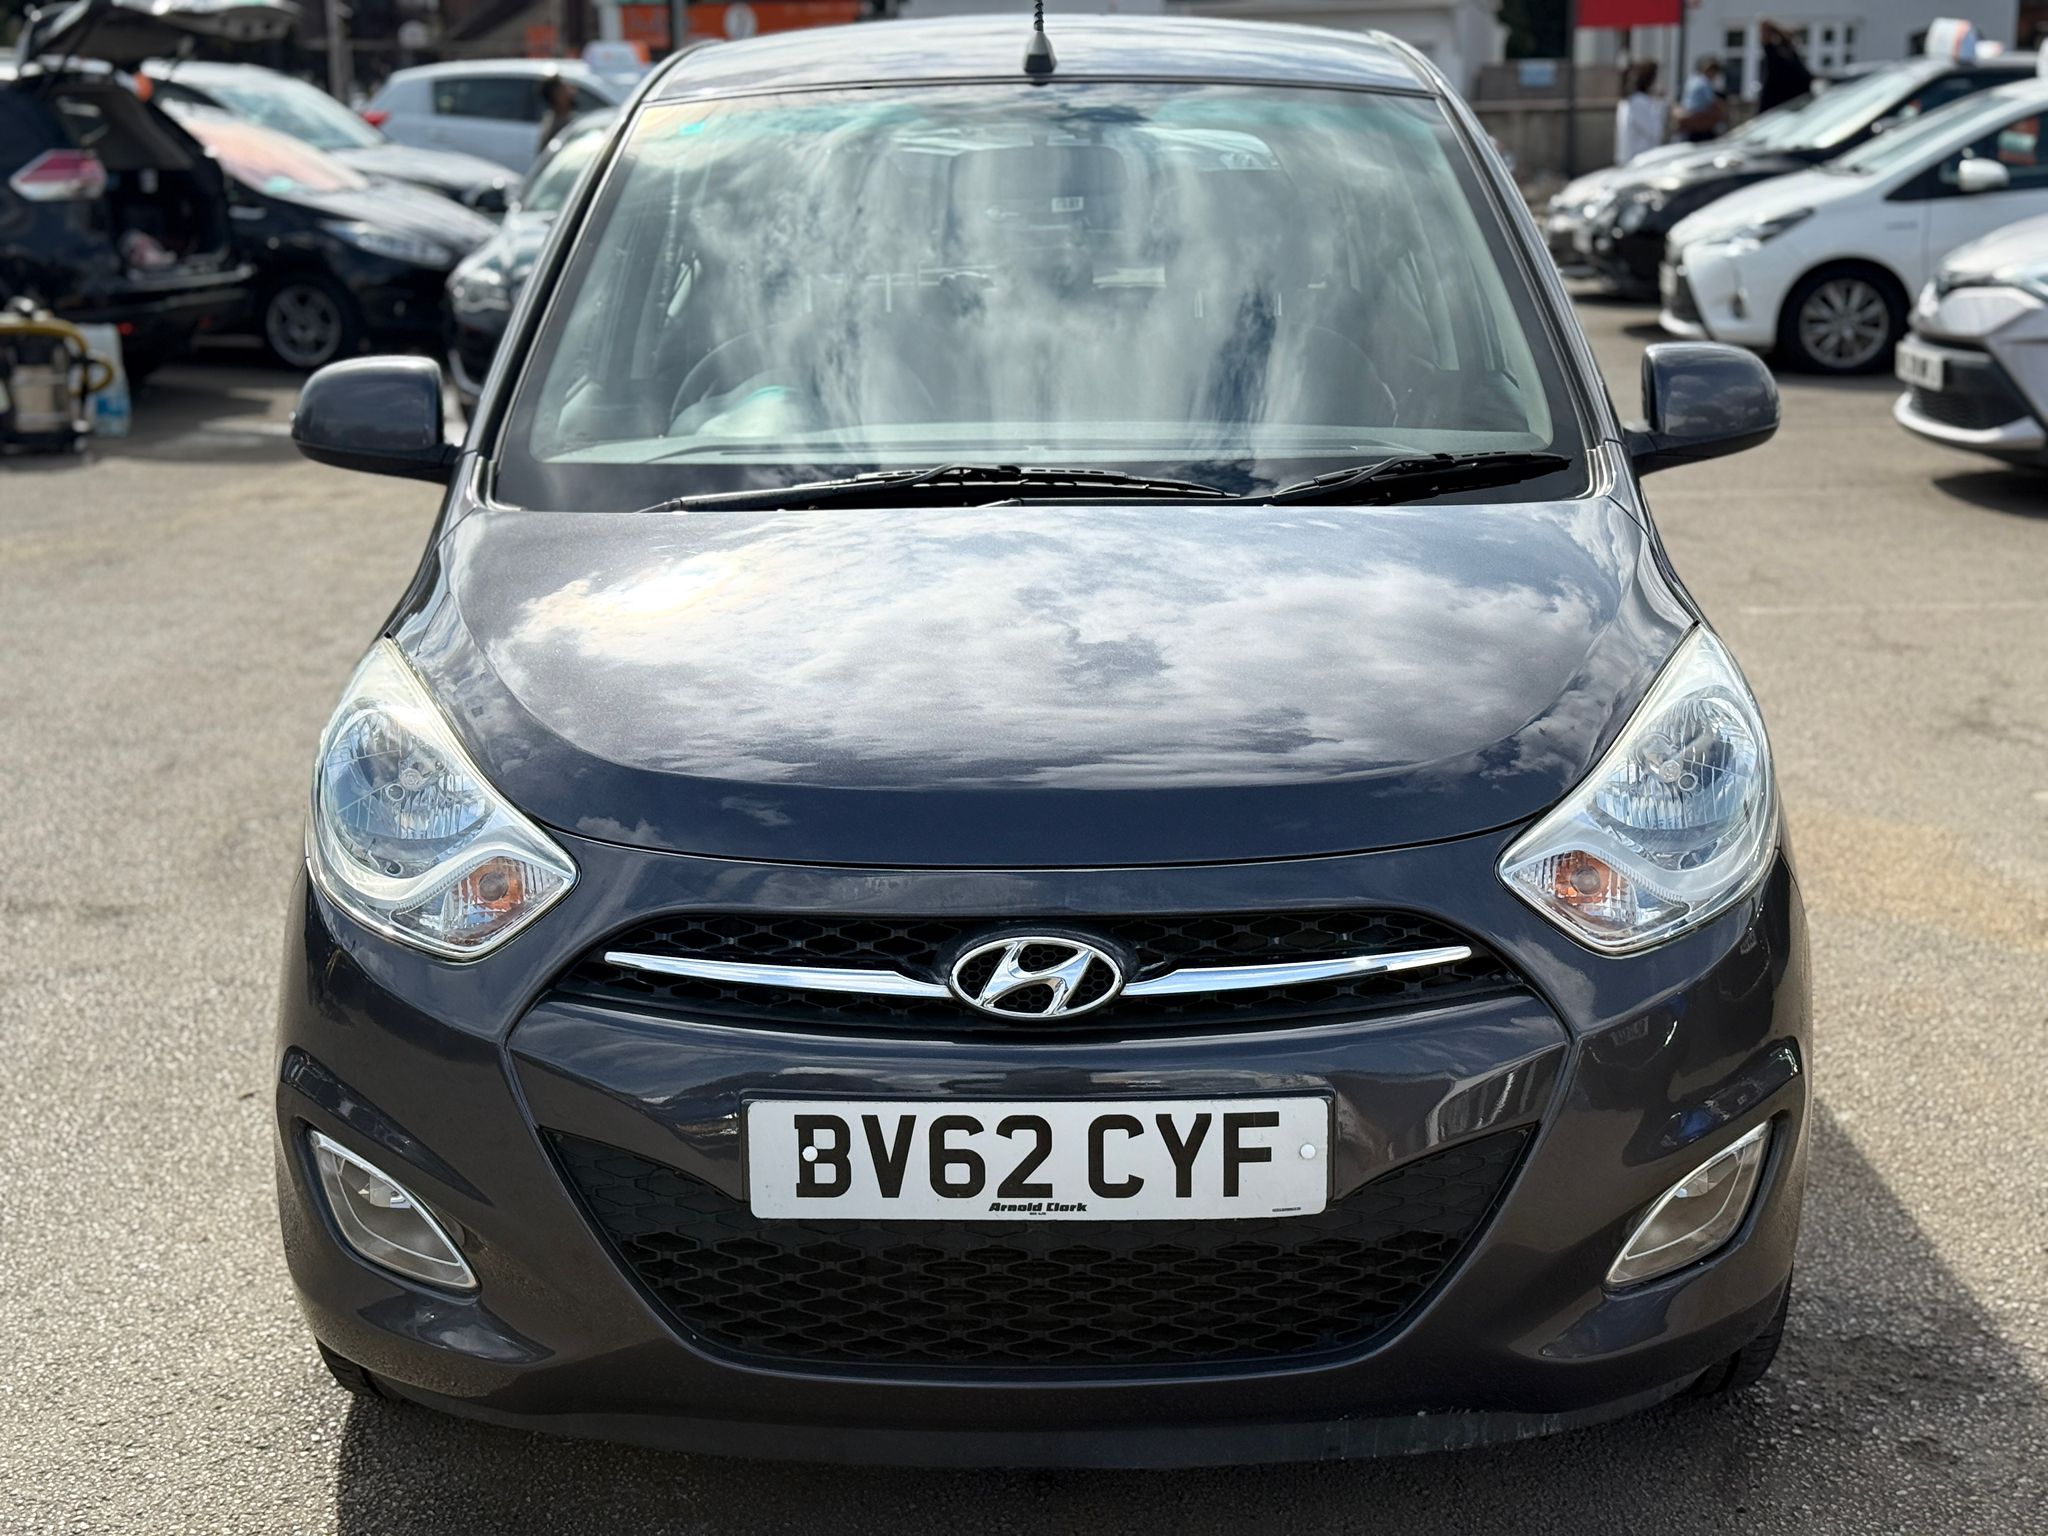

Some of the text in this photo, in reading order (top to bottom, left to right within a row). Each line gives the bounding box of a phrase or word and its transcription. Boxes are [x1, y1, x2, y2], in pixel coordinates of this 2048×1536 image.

[794, 1112, 1280, 1199] BV62 CYF
[989, 1202, 1088, 1212] Arnold Clark
